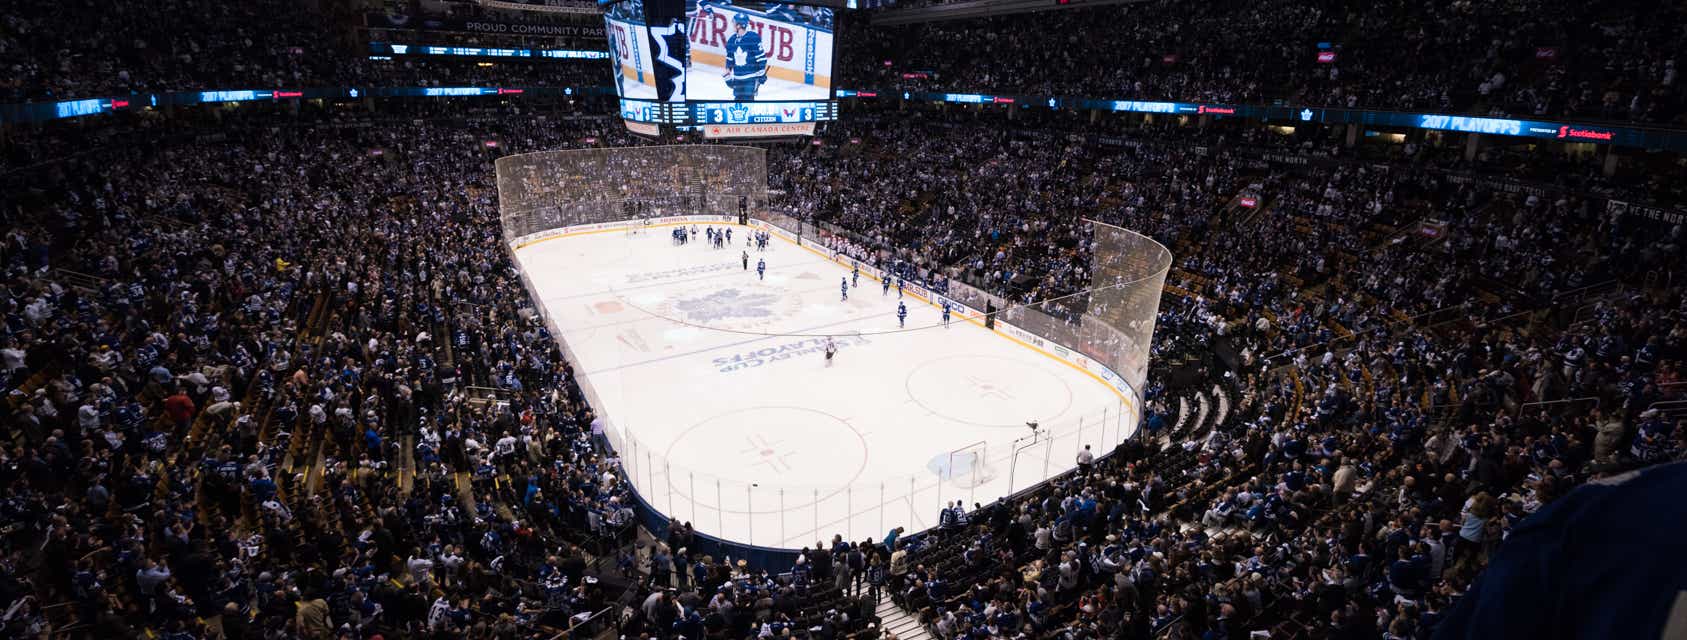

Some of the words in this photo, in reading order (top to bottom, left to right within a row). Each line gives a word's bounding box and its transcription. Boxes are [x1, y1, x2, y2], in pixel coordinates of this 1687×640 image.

[466, 22, 506, 33] PROUD
[511, 23, 579, 35] COMMUNITY
[807, 29, 816, 75] Reebok
[714, 109, 723, 122] 3
[804, 109, 811, 121] 3
[1420, 114, 1448, 128] 2017
[1451, 116, 1521, 136] PLAYOFFS
[1569, 128, 1612, 140] Scotiabank
[1643, 207, 1662, 220] THE
[1663, 211, 1687, 225] NOR
[719, 359, 763, 372] CUP
[430, 605, 444, 622] 13
